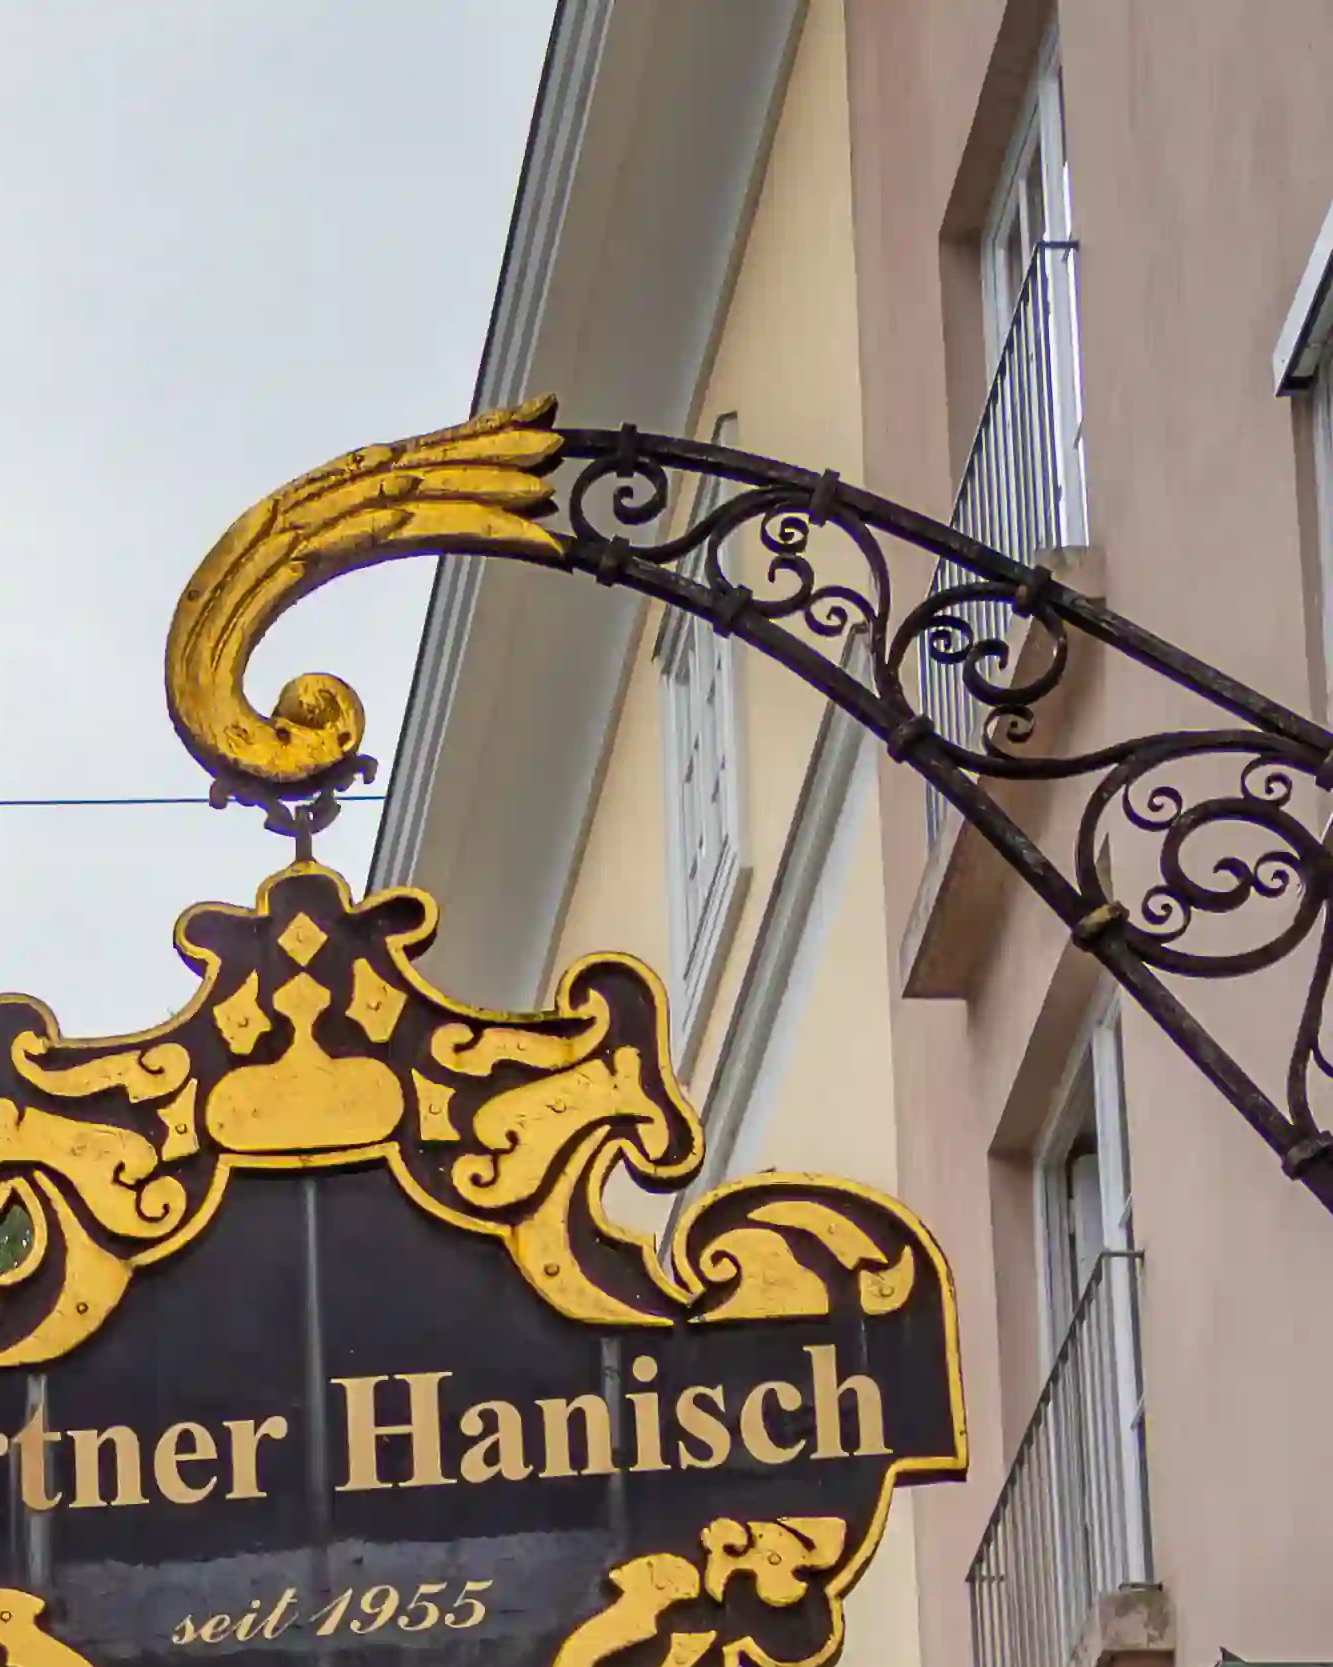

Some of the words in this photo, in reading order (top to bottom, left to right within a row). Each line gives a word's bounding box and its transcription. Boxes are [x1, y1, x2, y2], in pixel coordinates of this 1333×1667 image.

[330, 1343, 893, 1492] Hanisch
[173, 1586, 311, 1645] seit
[313, 1579, 494, 1637] 1955
